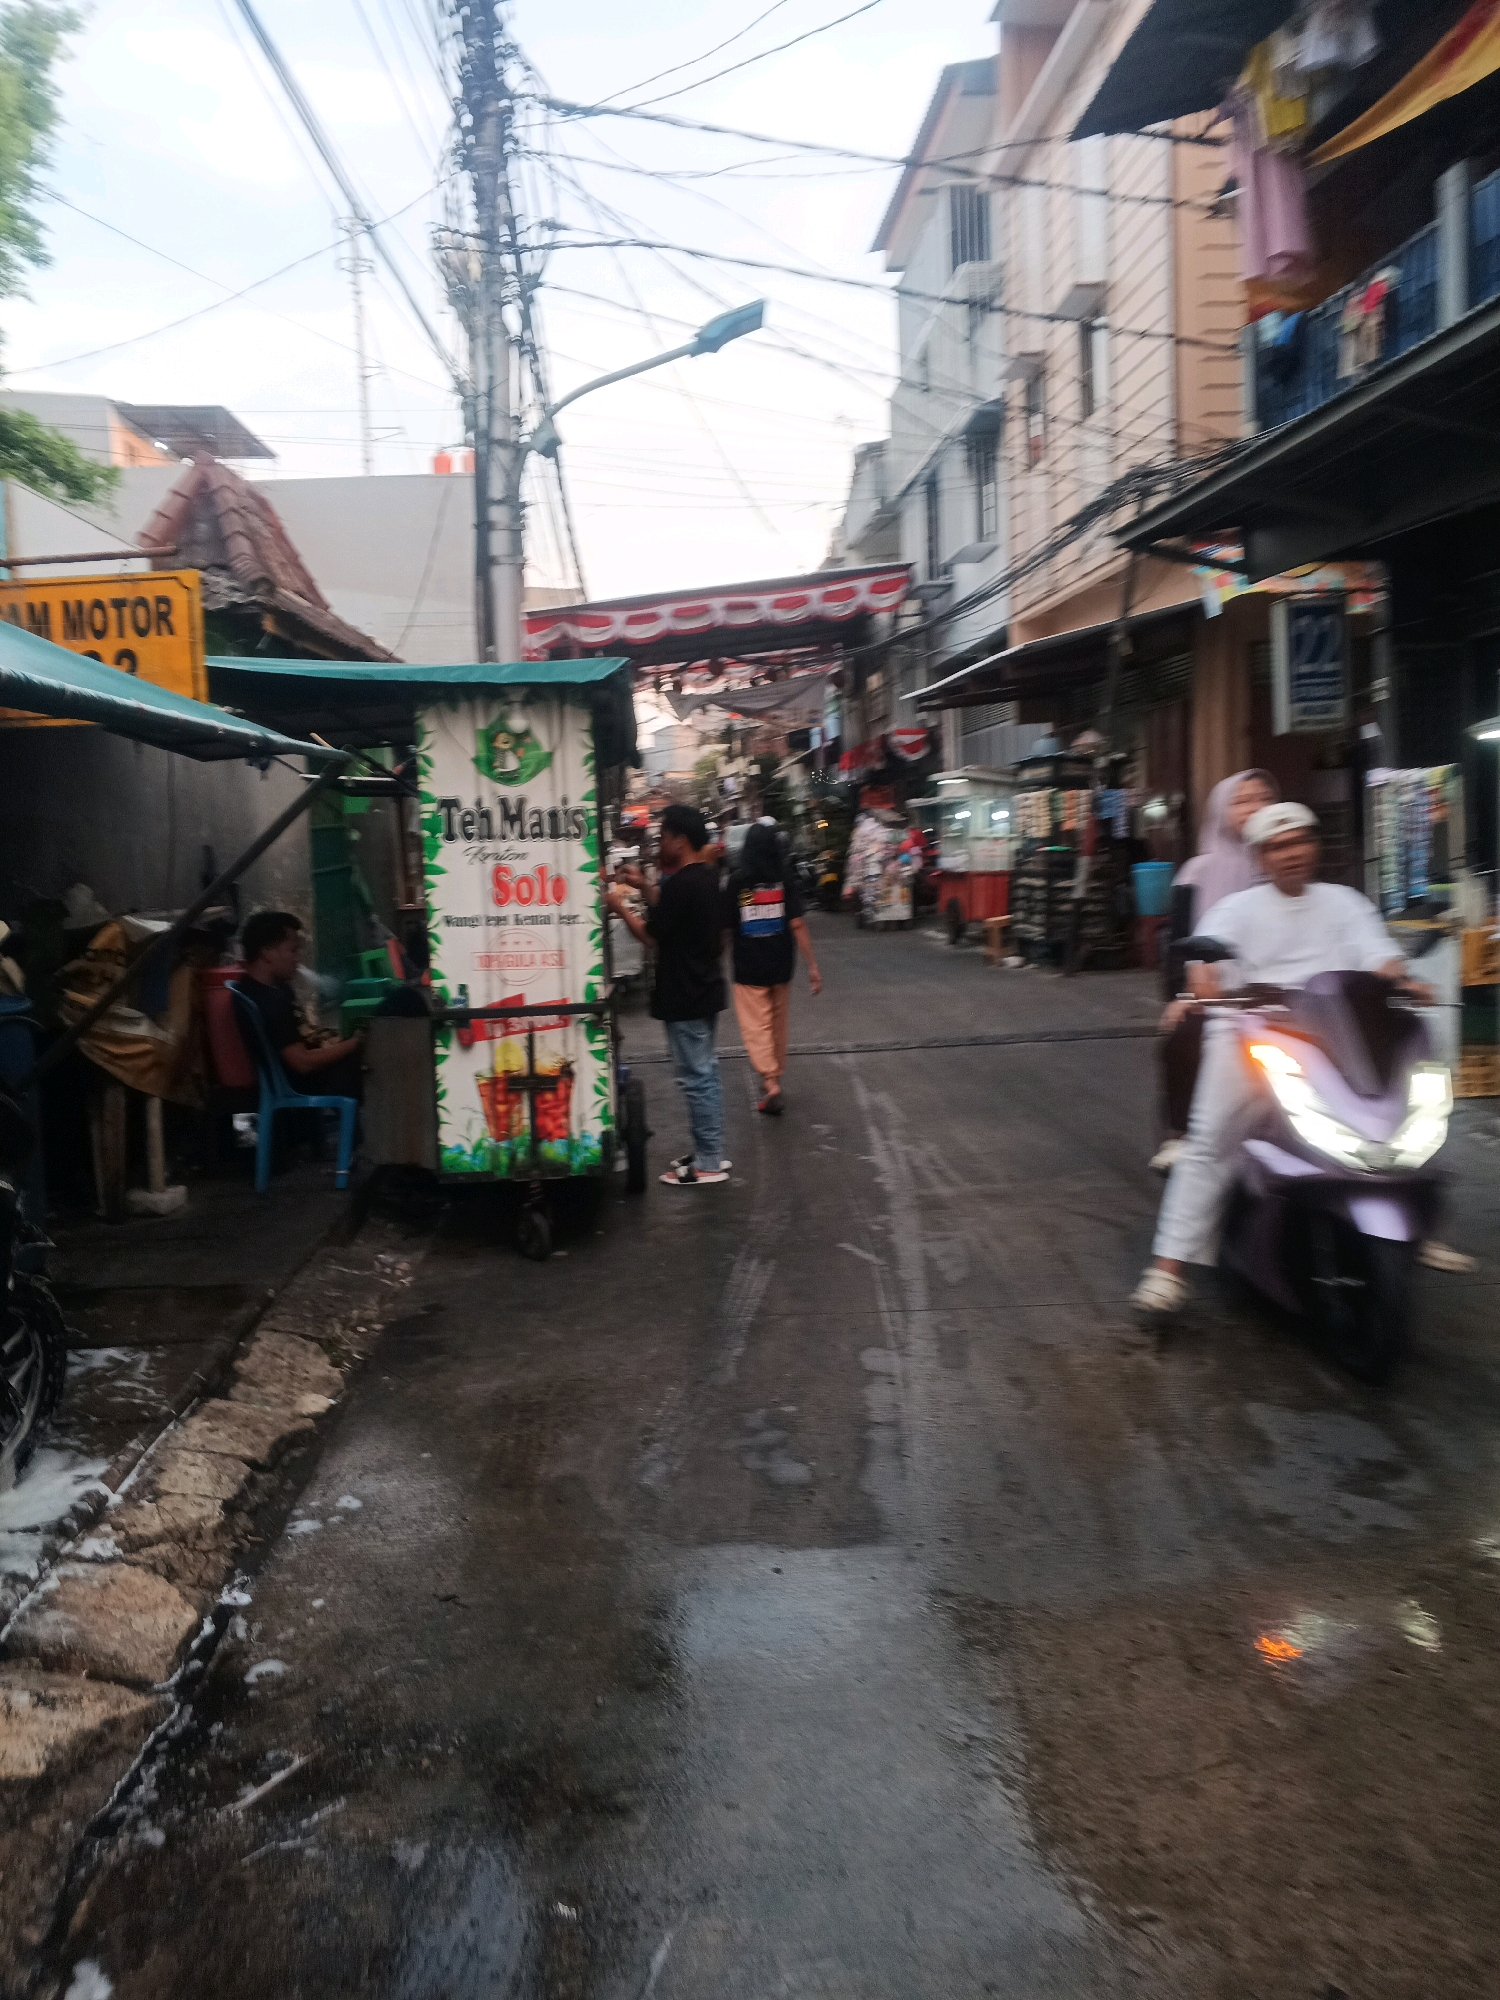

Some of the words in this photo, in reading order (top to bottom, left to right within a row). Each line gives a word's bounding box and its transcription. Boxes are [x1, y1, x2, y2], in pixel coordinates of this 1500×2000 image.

[62, 595, 175, 640] MOTOR
[436, 795, 492, 843] Teh
[498, 794, 588, 843] Manis
[491, 863, 568, 907] Solo
